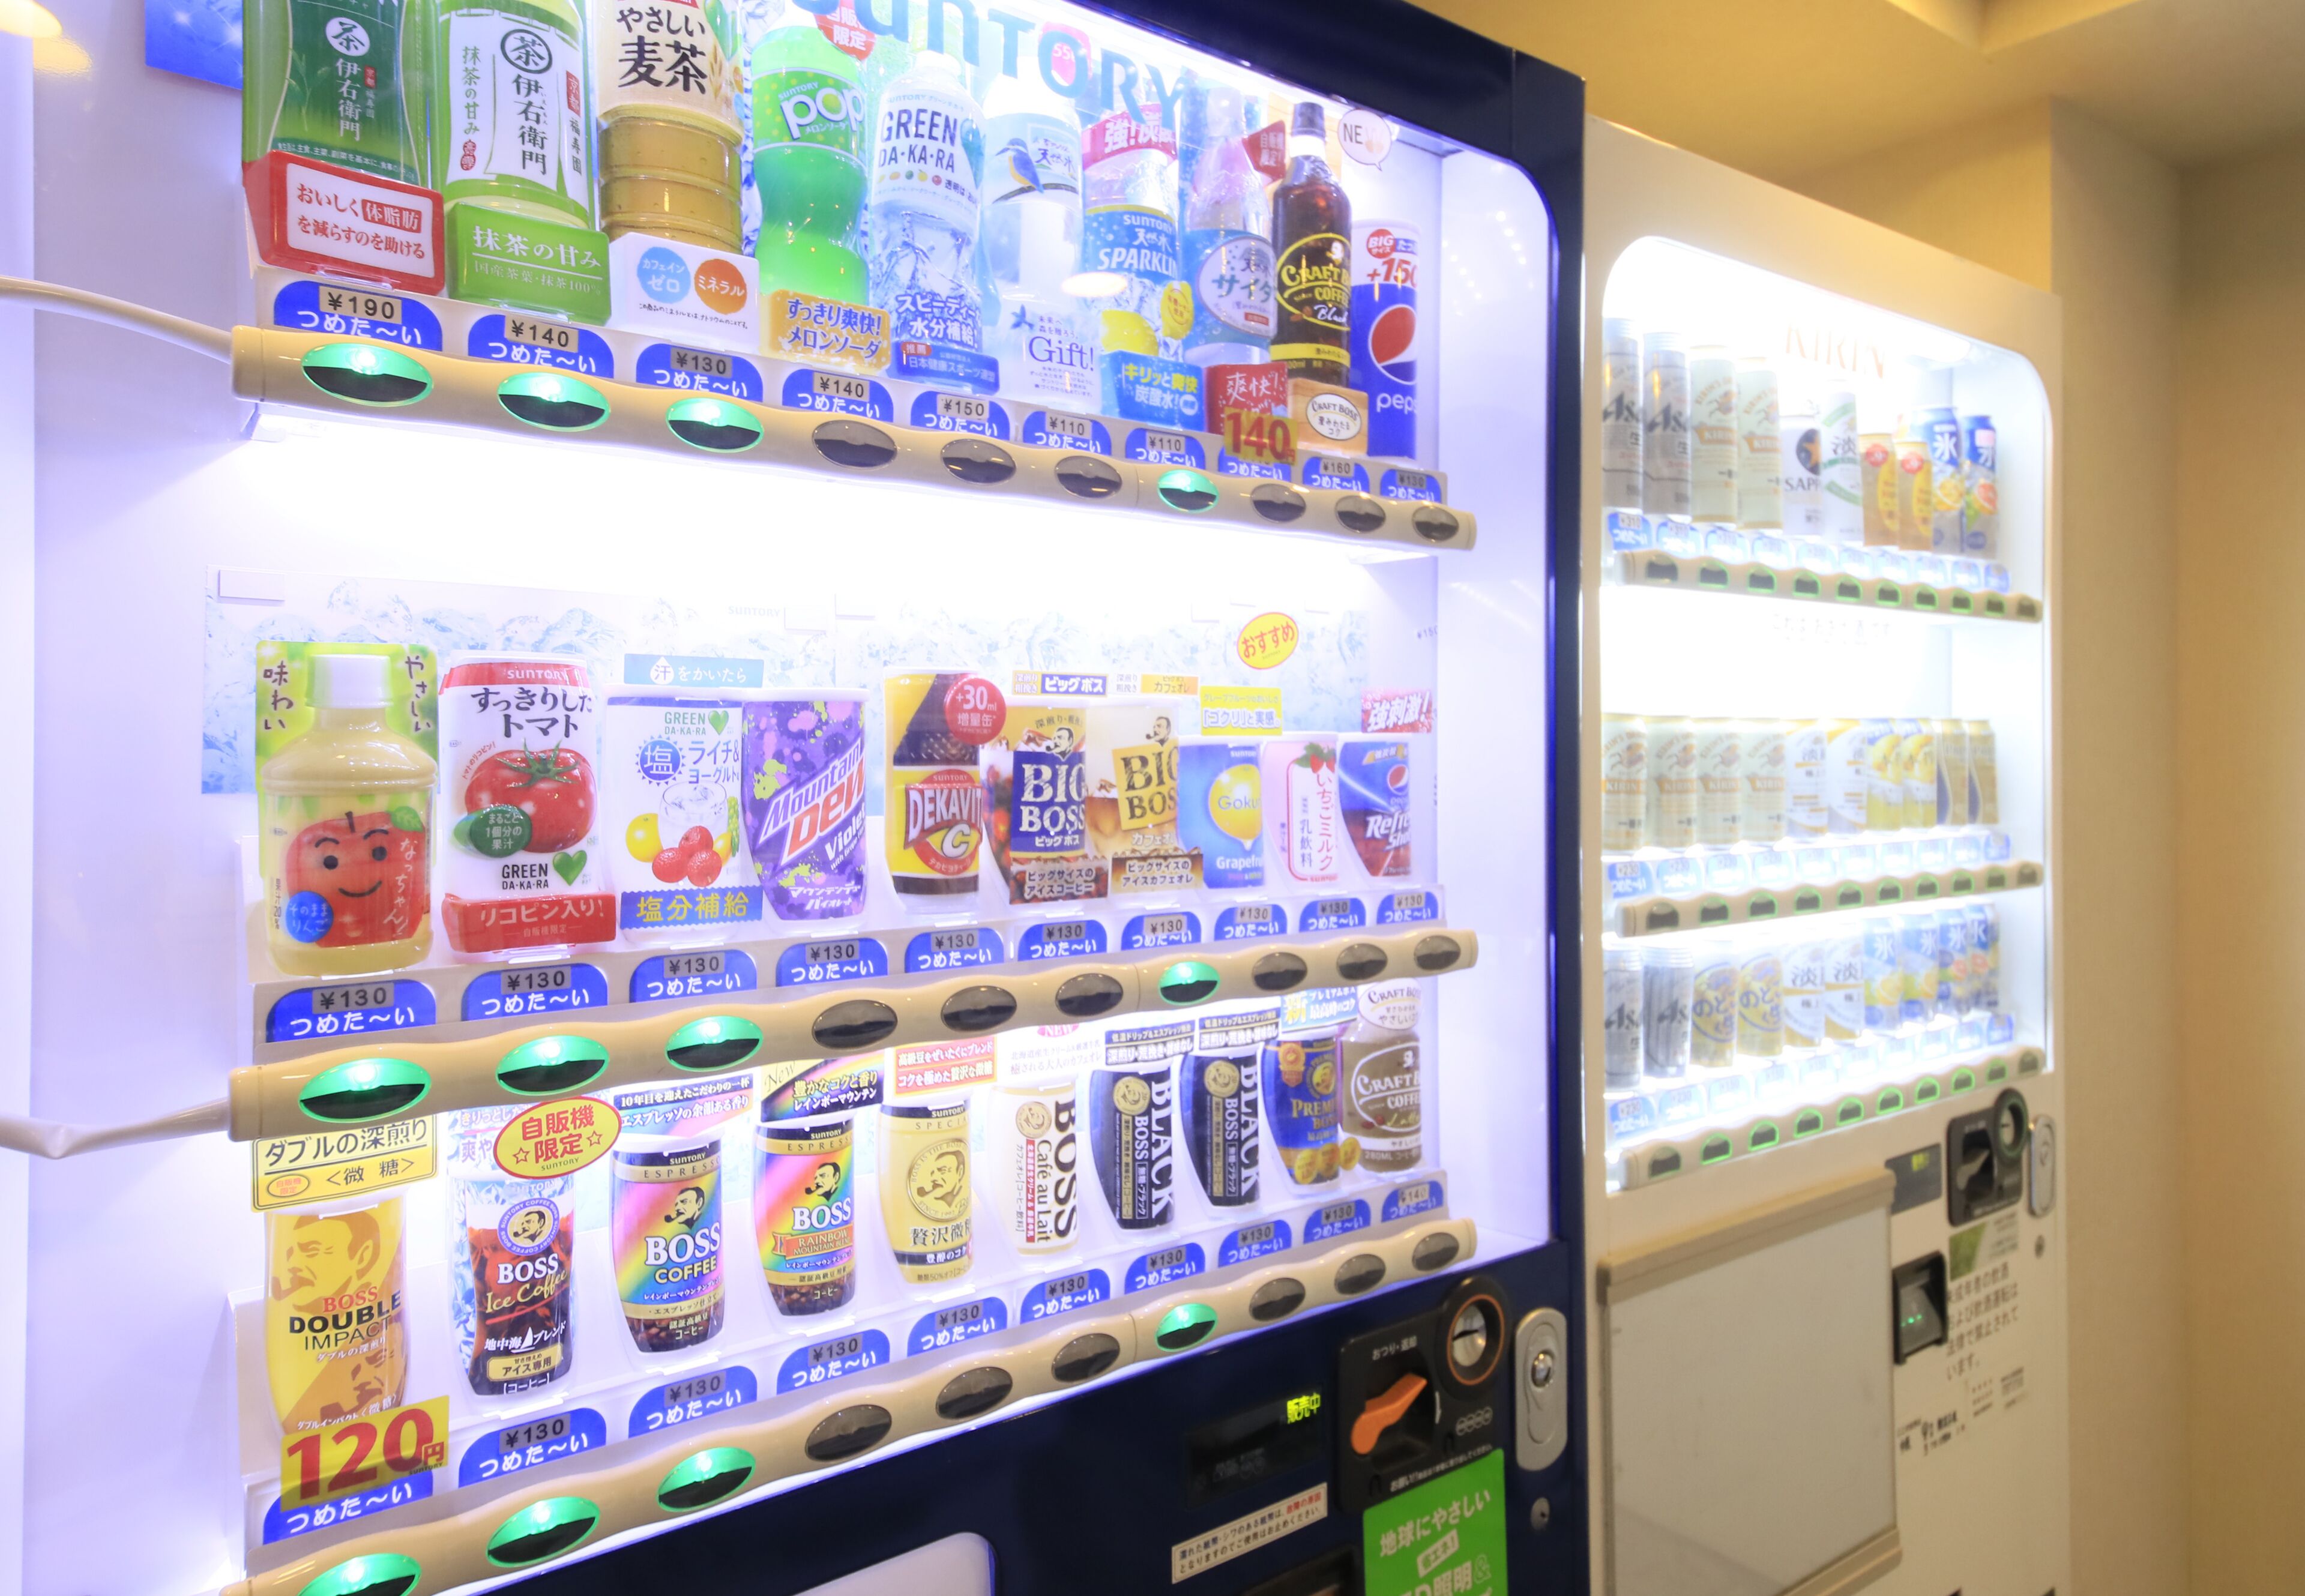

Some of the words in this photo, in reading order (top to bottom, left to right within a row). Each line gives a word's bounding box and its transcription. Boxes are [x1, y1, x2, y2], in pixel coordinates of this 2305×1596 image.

[616, 7, 707, 38] やさしい
[618, 35, 708, 95] 麦茶
[335, 58, 363, 142] 伊右衛門
[462, 45, 480, 136] 抹茶の甘み
[512, 74, 548, 176] 伊右衛門
[881, 109, 958, 147] GREEN
[297, 216, 426, 260] を減らすのを助ける
[472, 226, 602, 270] 抹茶の甘み
[1367, 235, 1394, 249] BIG
[642, 258, 686, 276] カフェイン
[647, 276, 681, 294] ゼロ
[698, 276, 745, 298] ミネラル
[327, 292, 396, 320] ¥190
[788, 298, 882, 337] すっきり爽快!
[511, 321, 570, 348] ¥140
[788, 330, 882, 360] メロンソーダ
[676, 352, 728, 376] ¥130
[1028, 336, 1094, 372] Gift!
[819, 376, 865, 399] ¥140
[943, 398, 984, 416] ¥150
[1241, 621, 1295, 659] おすすめ
[654, 664, 747, 684] 汗をかいたら
[262, 660, 294, 731] 味わい
[405, 655, 432, 733] やさしい
[471, 686, 594, 714] すっきりした
[502, 713, 580, 739] トマト
[664, 711, 706, 725] GREEN
[487, 811, 521, 825] まるごと
[484, 825, 522, 839] 1個分の
[491, 837, 515, 850] 果汁
[501, 863, 549, 880] GREEN
[1027, 868, 1094, 882] ビッグサイズの
[1128, 860, 1190, 873] ビッグサイズの
[1026, 883, 1094, 896] アイスコーヒー
[1122, 875, 1193, 888] アイスカフェオレ
[480, 897, 604, 928] リコピン入り!
[636, 891, 750, 923] 塩分補給
[934, 933, 975, 949] ¥130
[1046, 924, 1082, 939] ¥130
[669, 957, 720, 975] ¥130
[810, 944, 855, 961] ¥130
[507, 969, 566, 990] ¥130
[319, 987, 387, 1010] ¥130
[794, 1087, 877, 1112] レインボーマウンテン
[521, 1107, 595, 1140] 自販機
[265, 1118, 428, 1167] ダブルの深煎り
[534, 1133, 583, 1164] 限定
[1134, 1115, 1149, 1160] BOSS
[792, 1197, 852, 1232] BOSS
[645, 1221, 720, 1266] BOSS
[497, 1253, 559, 1285] BOSS
[654, 1255, 717, 1284] COFFEE
[1048, 1276, 1085, 1296] ¥130
[289, 1289, 402, 1334] DOUBLE
[322, 1286, 379, 1314] BOSS
[486, 1290, 515, 1314] Ice
[939, 1304, 980, 1326] ¥130
[304, 1316, 391, 1351] IMPACT
[675, 1326, 705, 1340] コーヒー
[812, 1338, 858, 1363] ¥130
[502, 1356, 552, 1376] アイス専用
[669, 1376, 721, 1402] ¥130
[1286, 1391, 1321, 1424] 販売中
[503, 1419, 565, 1448] ¥130
[1380, 1489, 1491, 1557] 地球にやさしい
